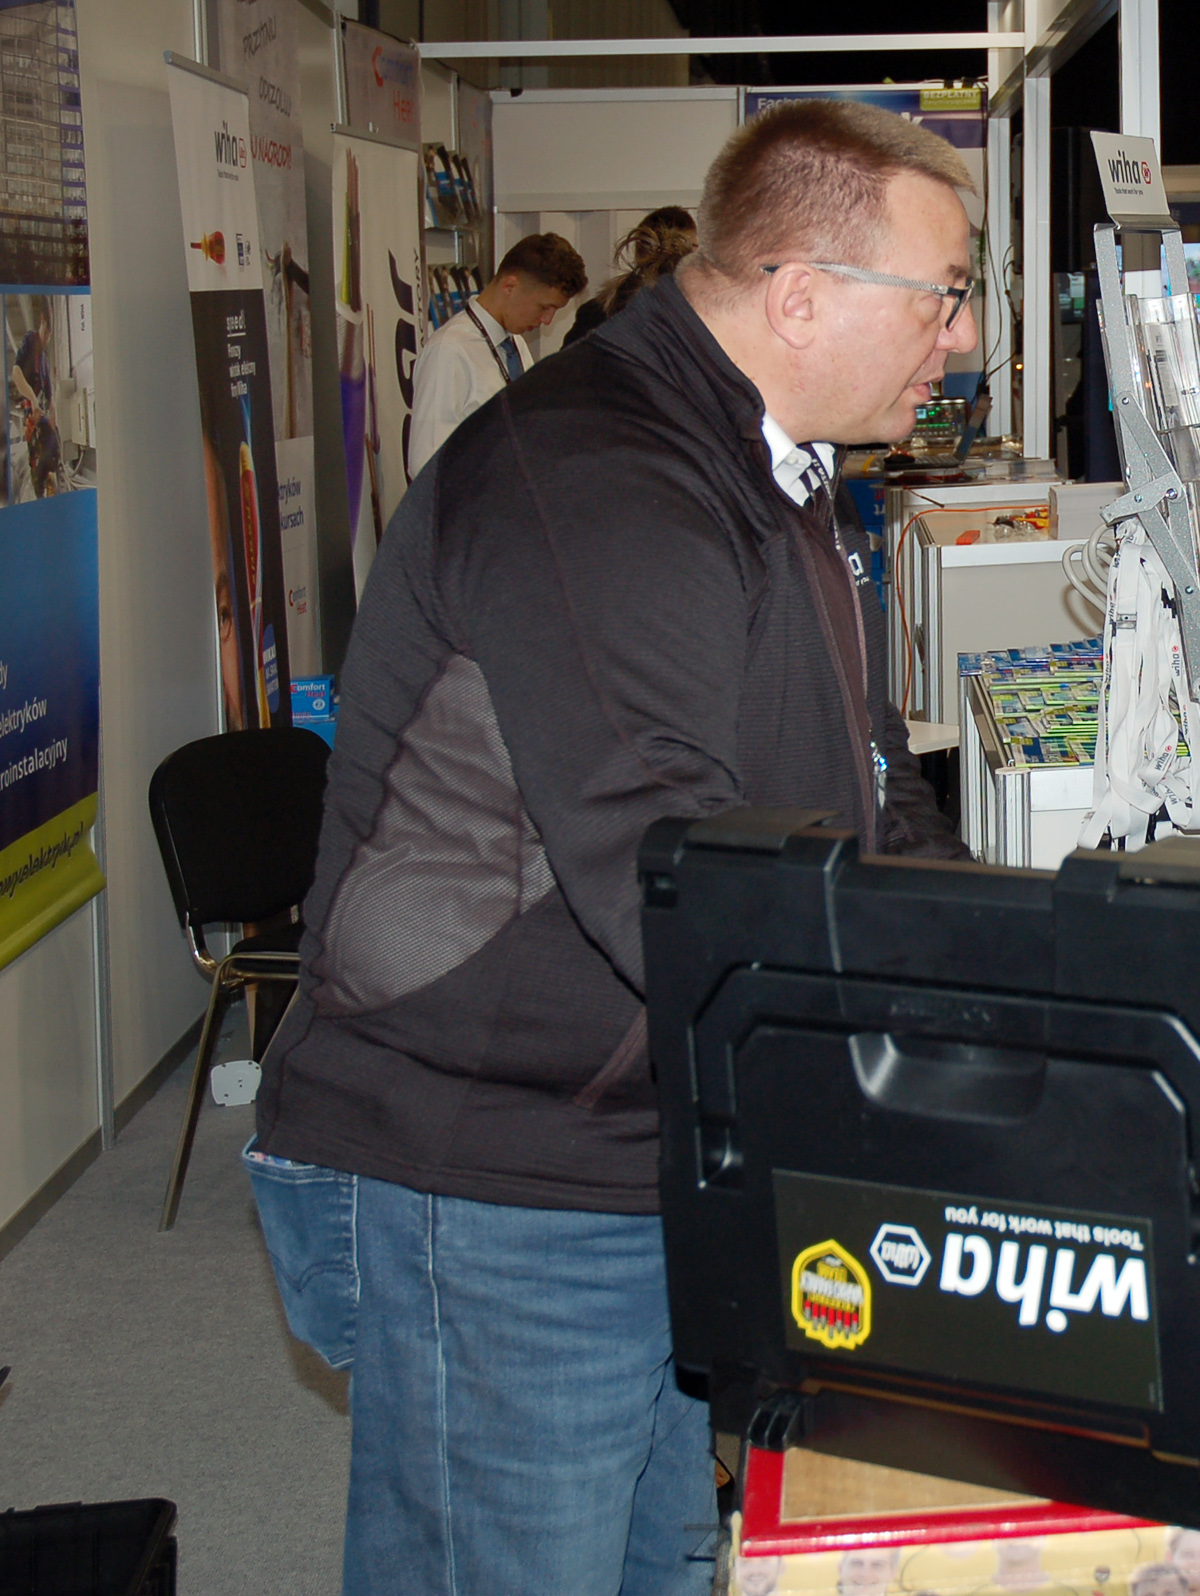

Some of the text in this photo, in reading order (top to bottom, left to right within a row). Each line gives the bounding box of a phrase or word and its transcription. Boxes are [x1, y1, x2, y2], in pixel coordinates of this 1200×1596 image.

[1108, 150, 1142, 184] wiha
[289, 683, 325, 694] Comfort
[1155, 752, 1169, 771] wiha
[945, 1206, 1144, 1251] Tools that work for you
[939, 1232, 1150, 1333] wiha
